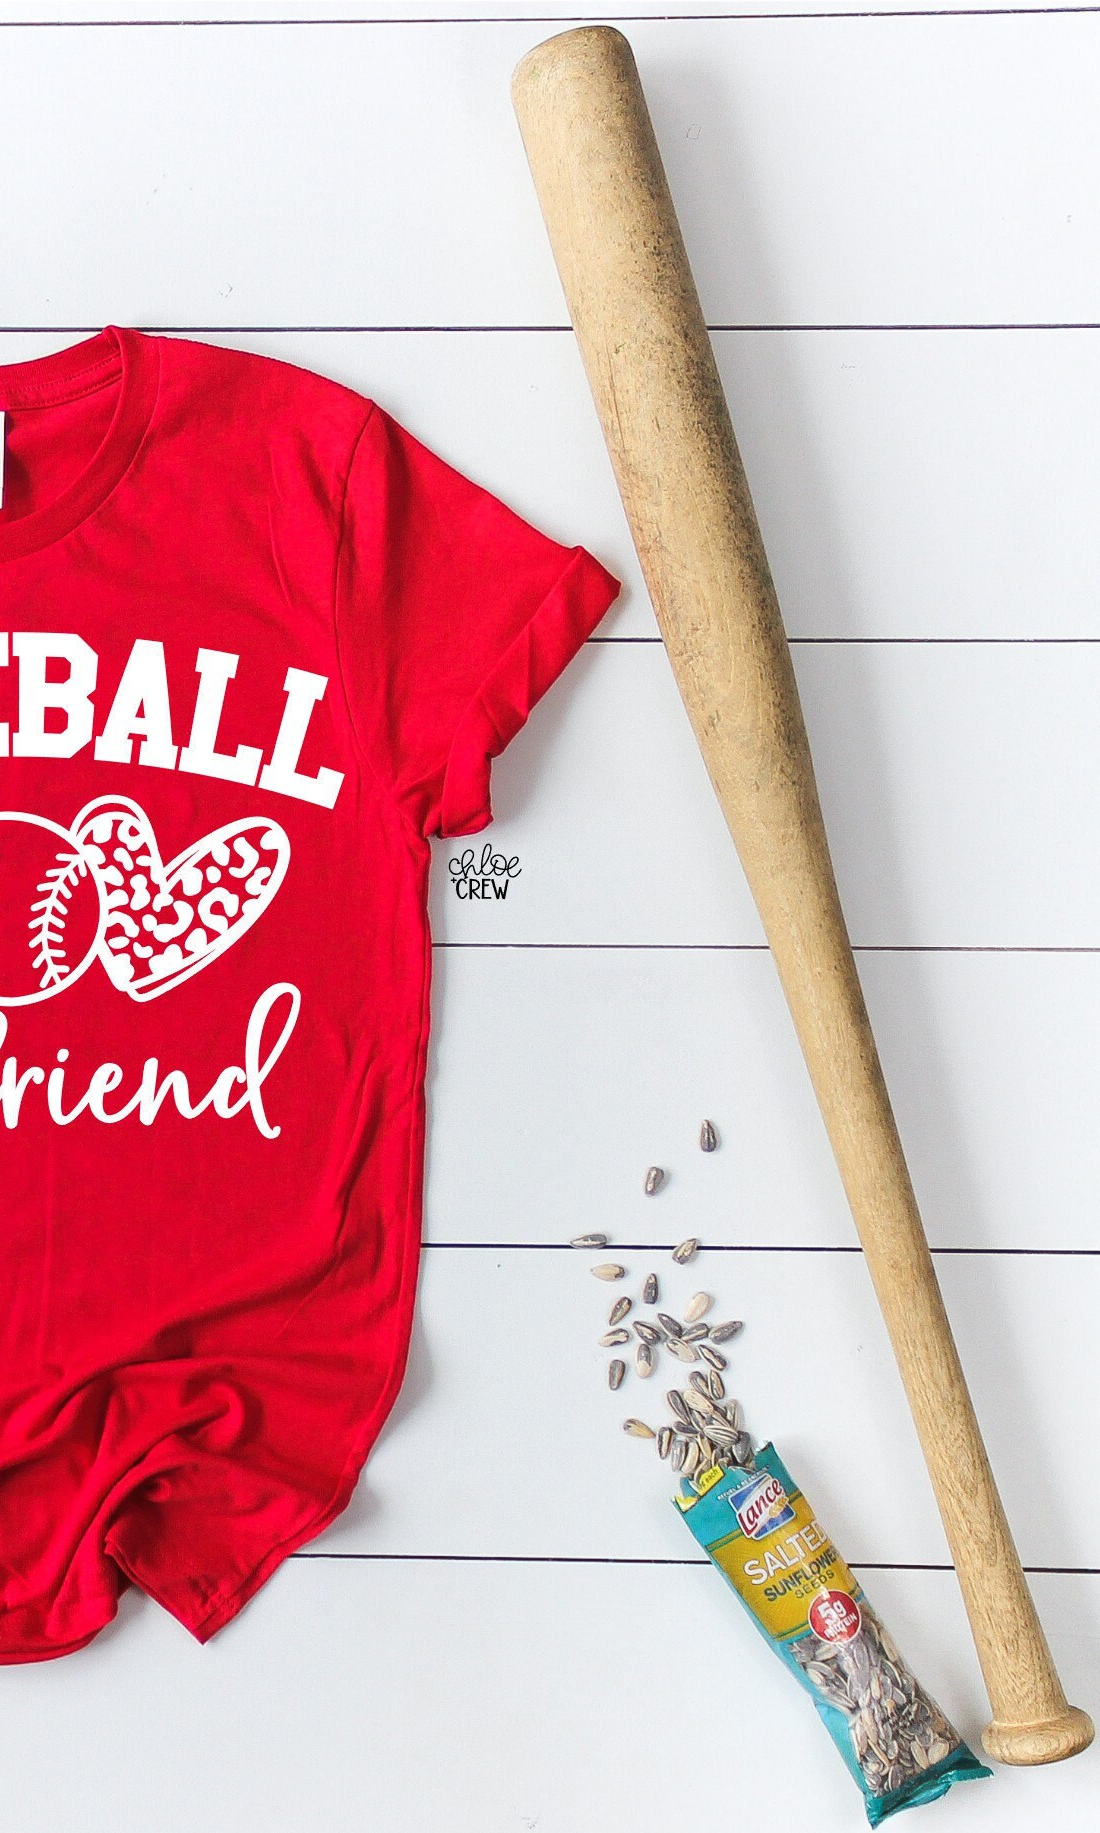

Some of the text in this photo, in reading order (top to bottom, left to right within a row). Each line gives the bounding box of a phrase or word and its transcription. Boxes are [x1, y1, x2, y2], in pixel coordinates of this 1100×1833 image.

[737, 1480, 782, 1536] Lance
[795, 1570, 835, 1599] SEEDS
[817, 1600, 847, 1626] 5g
